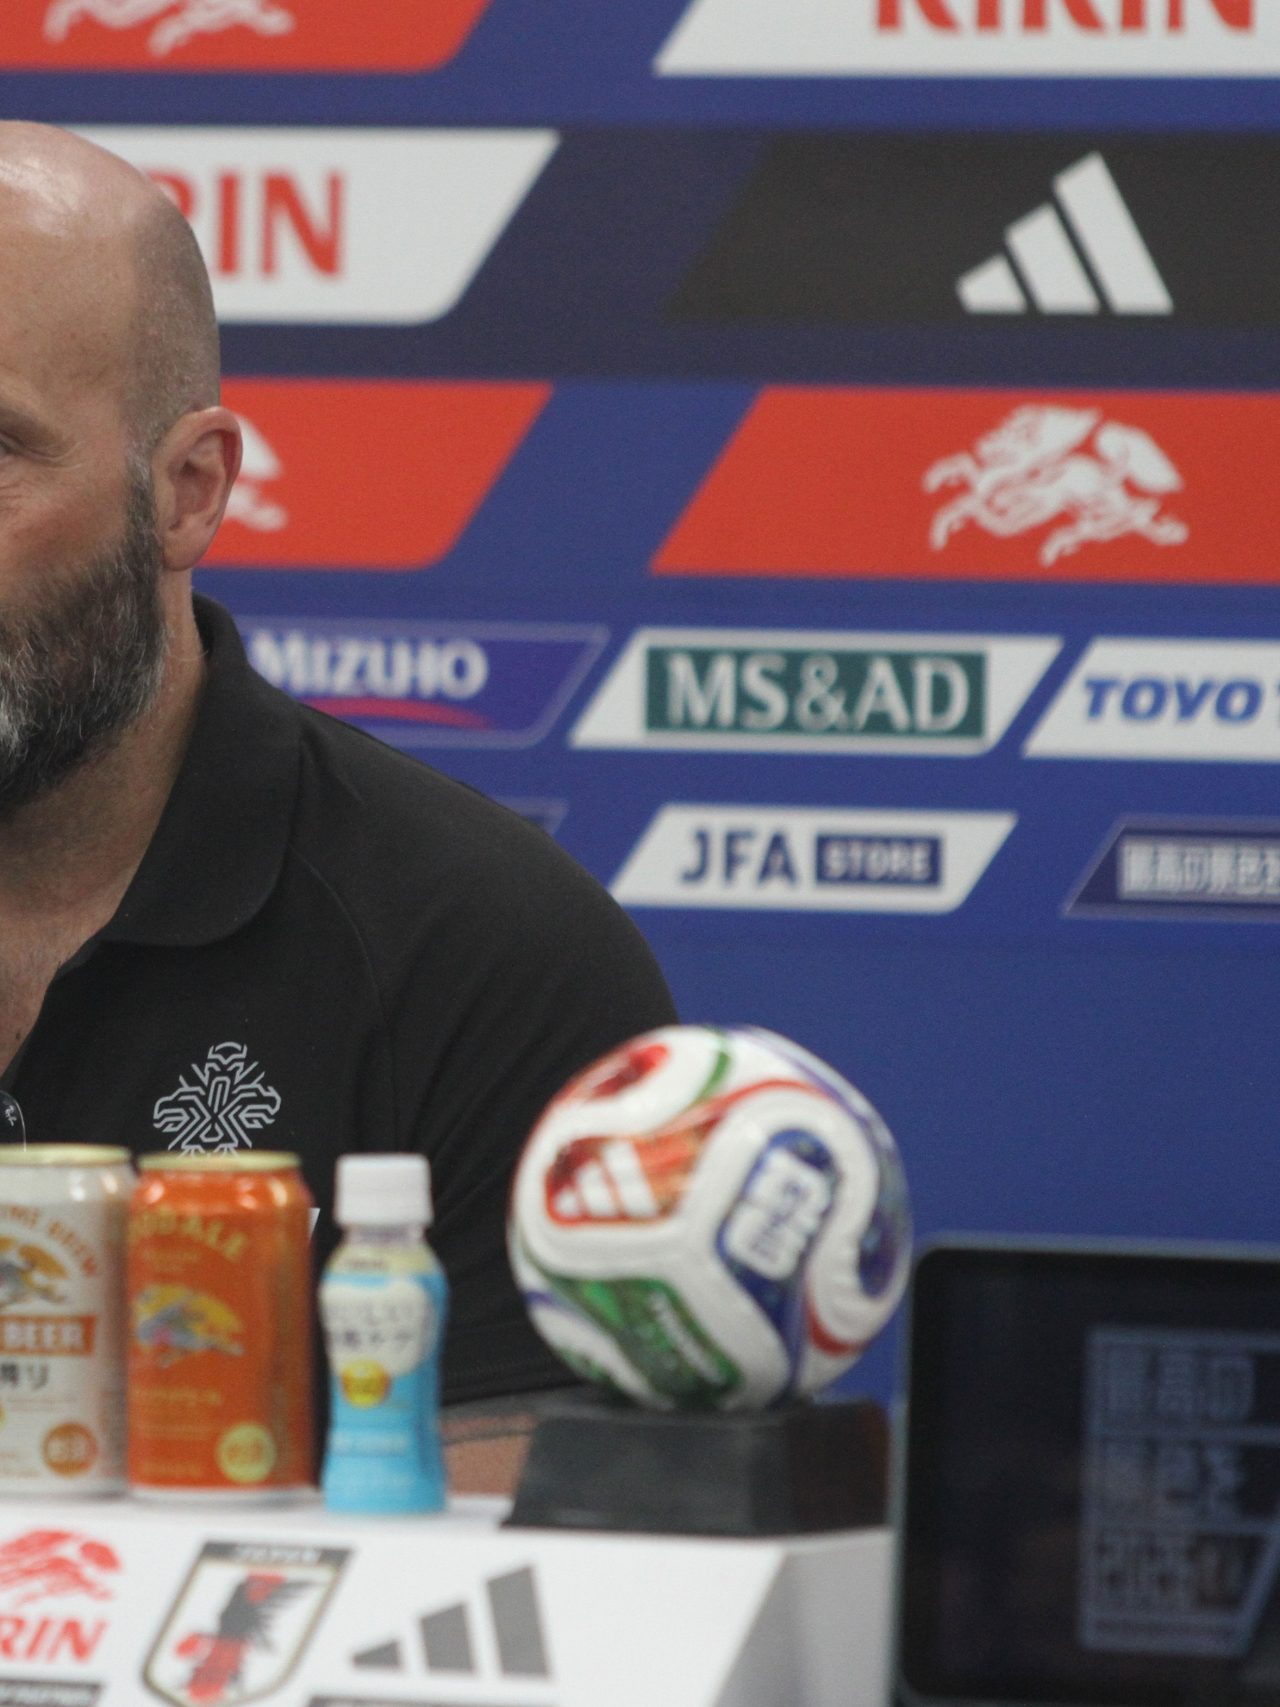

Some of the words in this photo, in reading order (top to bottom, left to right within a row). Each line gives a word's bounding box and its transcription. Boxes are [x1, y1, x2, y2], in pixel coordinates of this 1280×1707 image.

[248, 628, 490, 700] MIZUHO
[666, 652, 972, 735] MS&AD
[1084, 676, 1264, 724] TOYO
[678, 828, 800, 888] JFA
[820, 838, 936, 882] STORE
[4, 1320, 84, 1347] BEER
